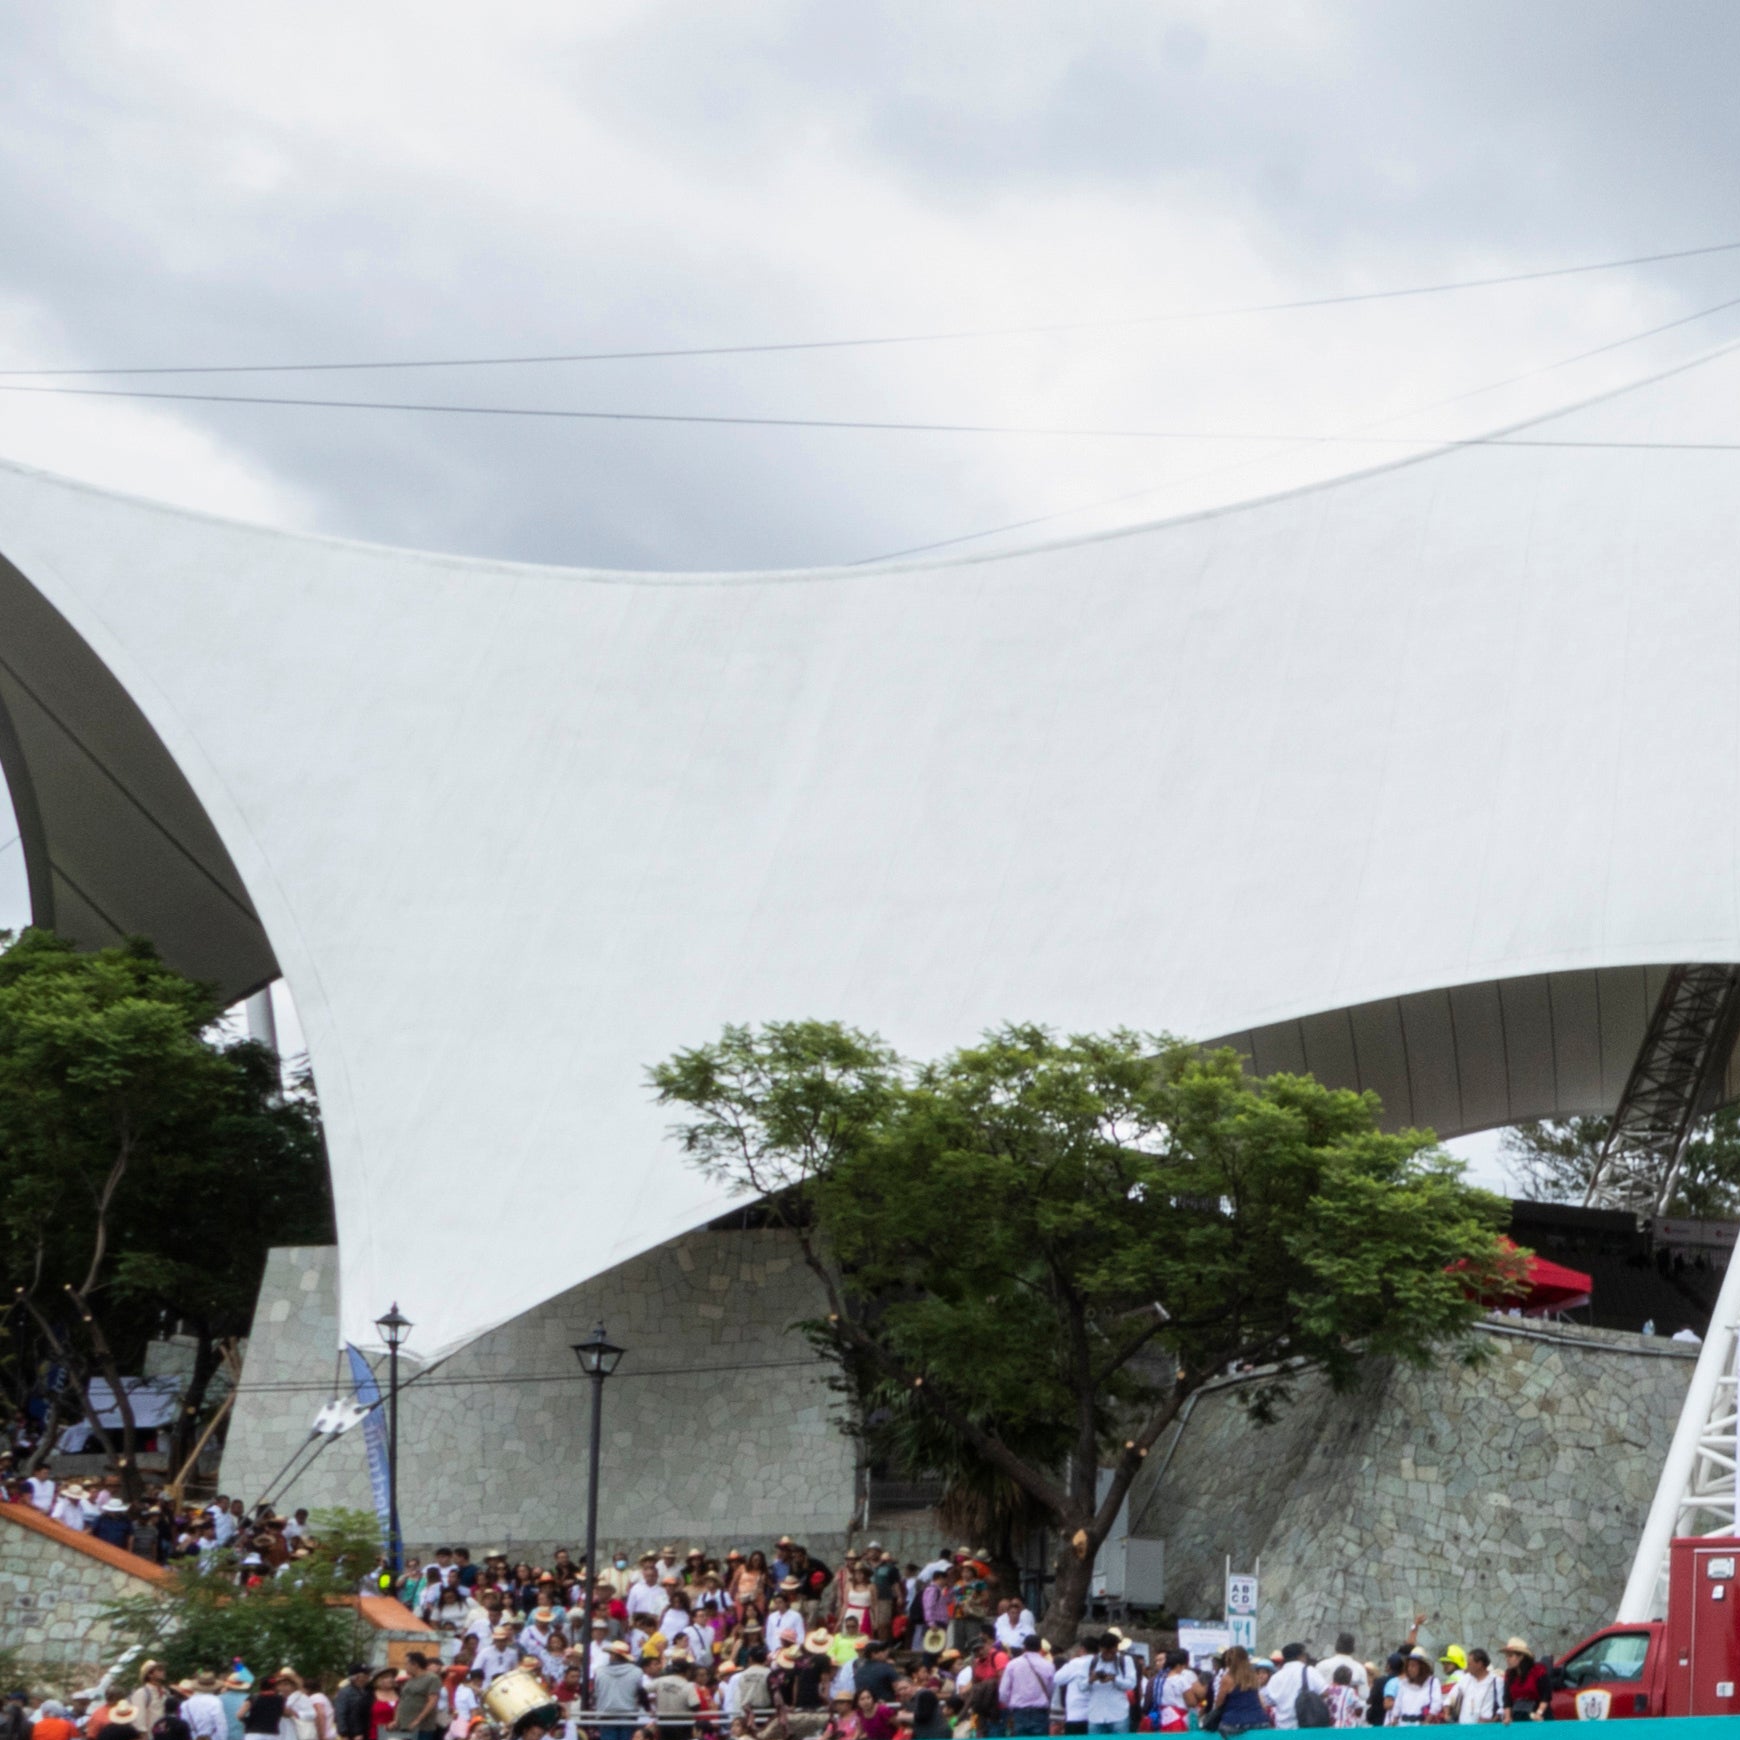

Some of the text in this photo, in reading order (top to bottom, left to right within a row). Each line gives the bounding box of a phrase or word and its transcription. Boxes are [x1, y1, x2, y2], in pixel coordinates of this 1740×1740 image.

[1231, 1584, 1250, 1594] A B
[1231, 1594, 1250, 1604] C D
